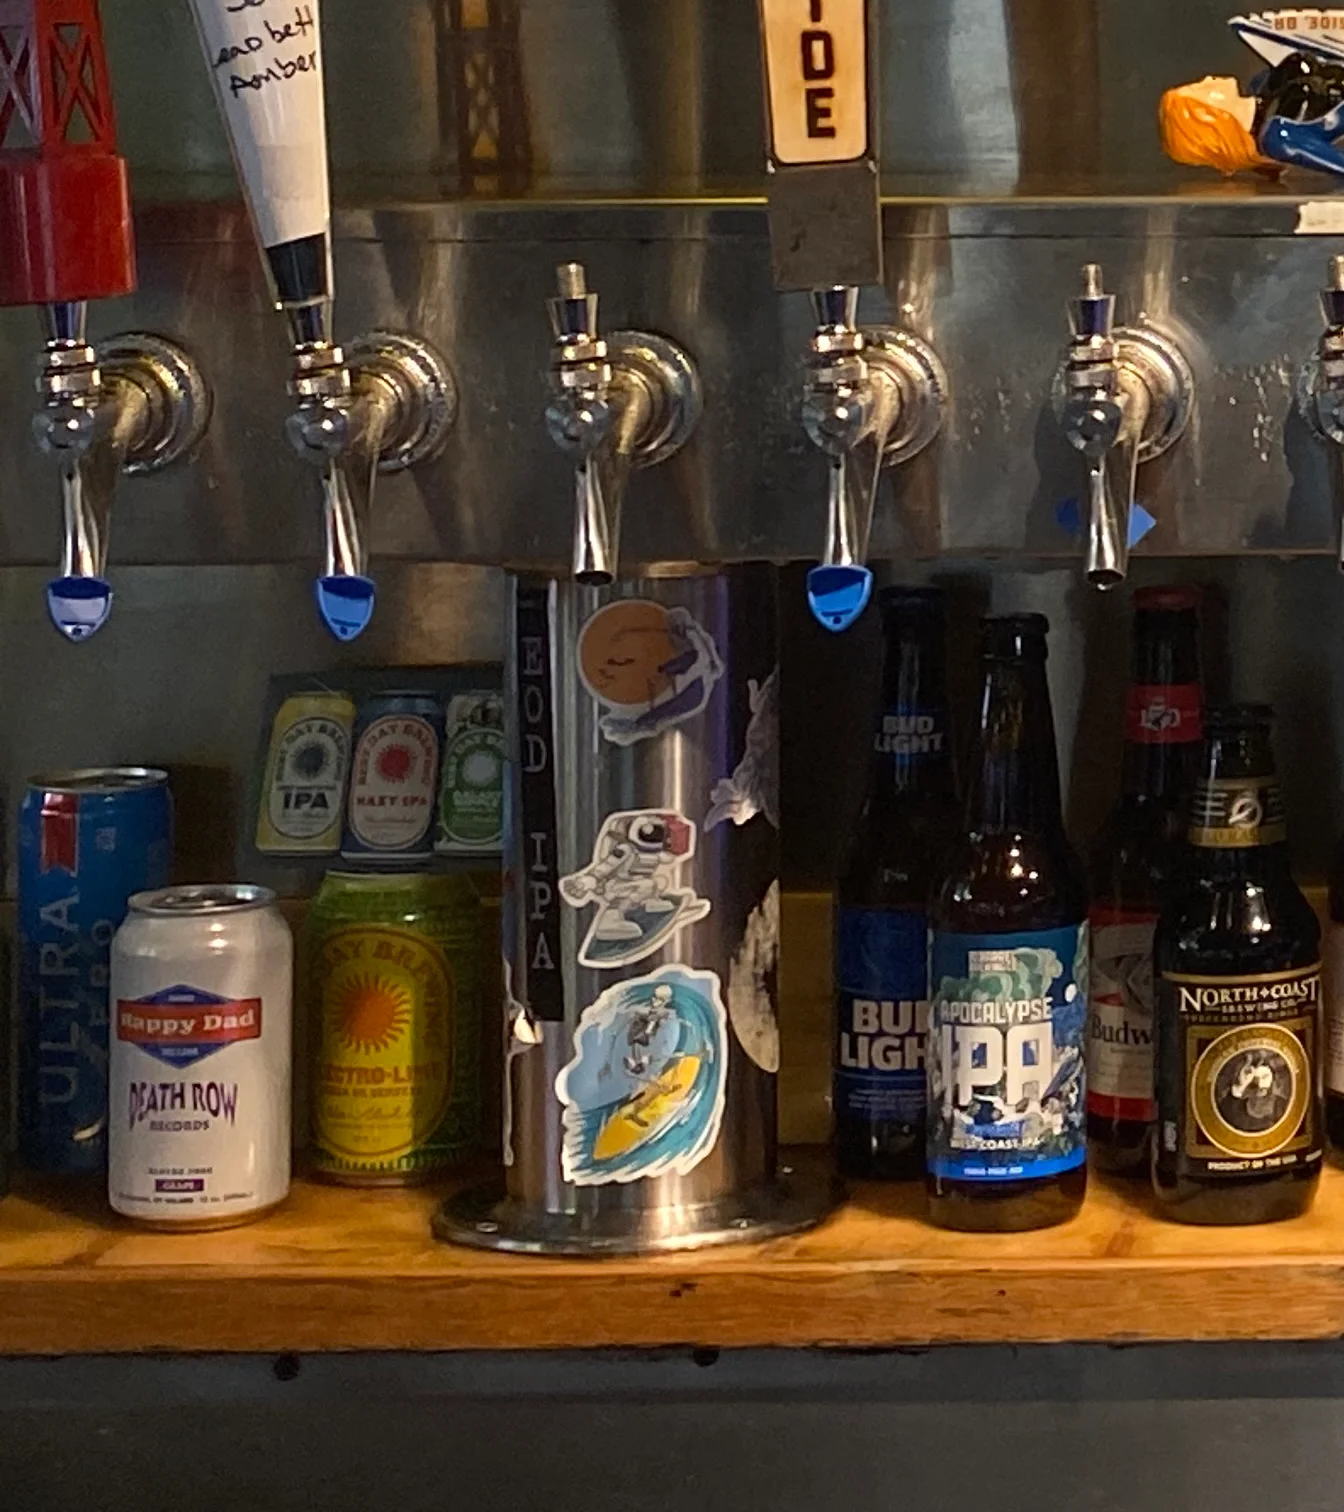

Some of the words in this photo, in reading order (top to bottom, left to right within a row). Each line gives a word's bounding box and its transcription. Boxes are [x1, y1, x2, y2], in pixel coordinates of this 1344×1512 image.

[882, 714, 935, 736] BUD
[282, 791, 330, 810] IPA
[38, 890, 82, 1106] ULTRA
[1178, 986, 1259, 1012] NORTH
[1269, 976, 1322, 999] COAST
[120, 1012, 197, 1035] Happy
[202, 1008, 255, 1032] Dad
[940, 996, 1054, 1025] APOCALYPSE
[941, 1022, 1054, 1109] IPA
[128, 1081, 186, 1132] DEATH
[191, 1081, 239, 1127] ROW
[149, 1119, 211, 1132] RECORDS
[978, 1137, 1019, 1151] COAST
